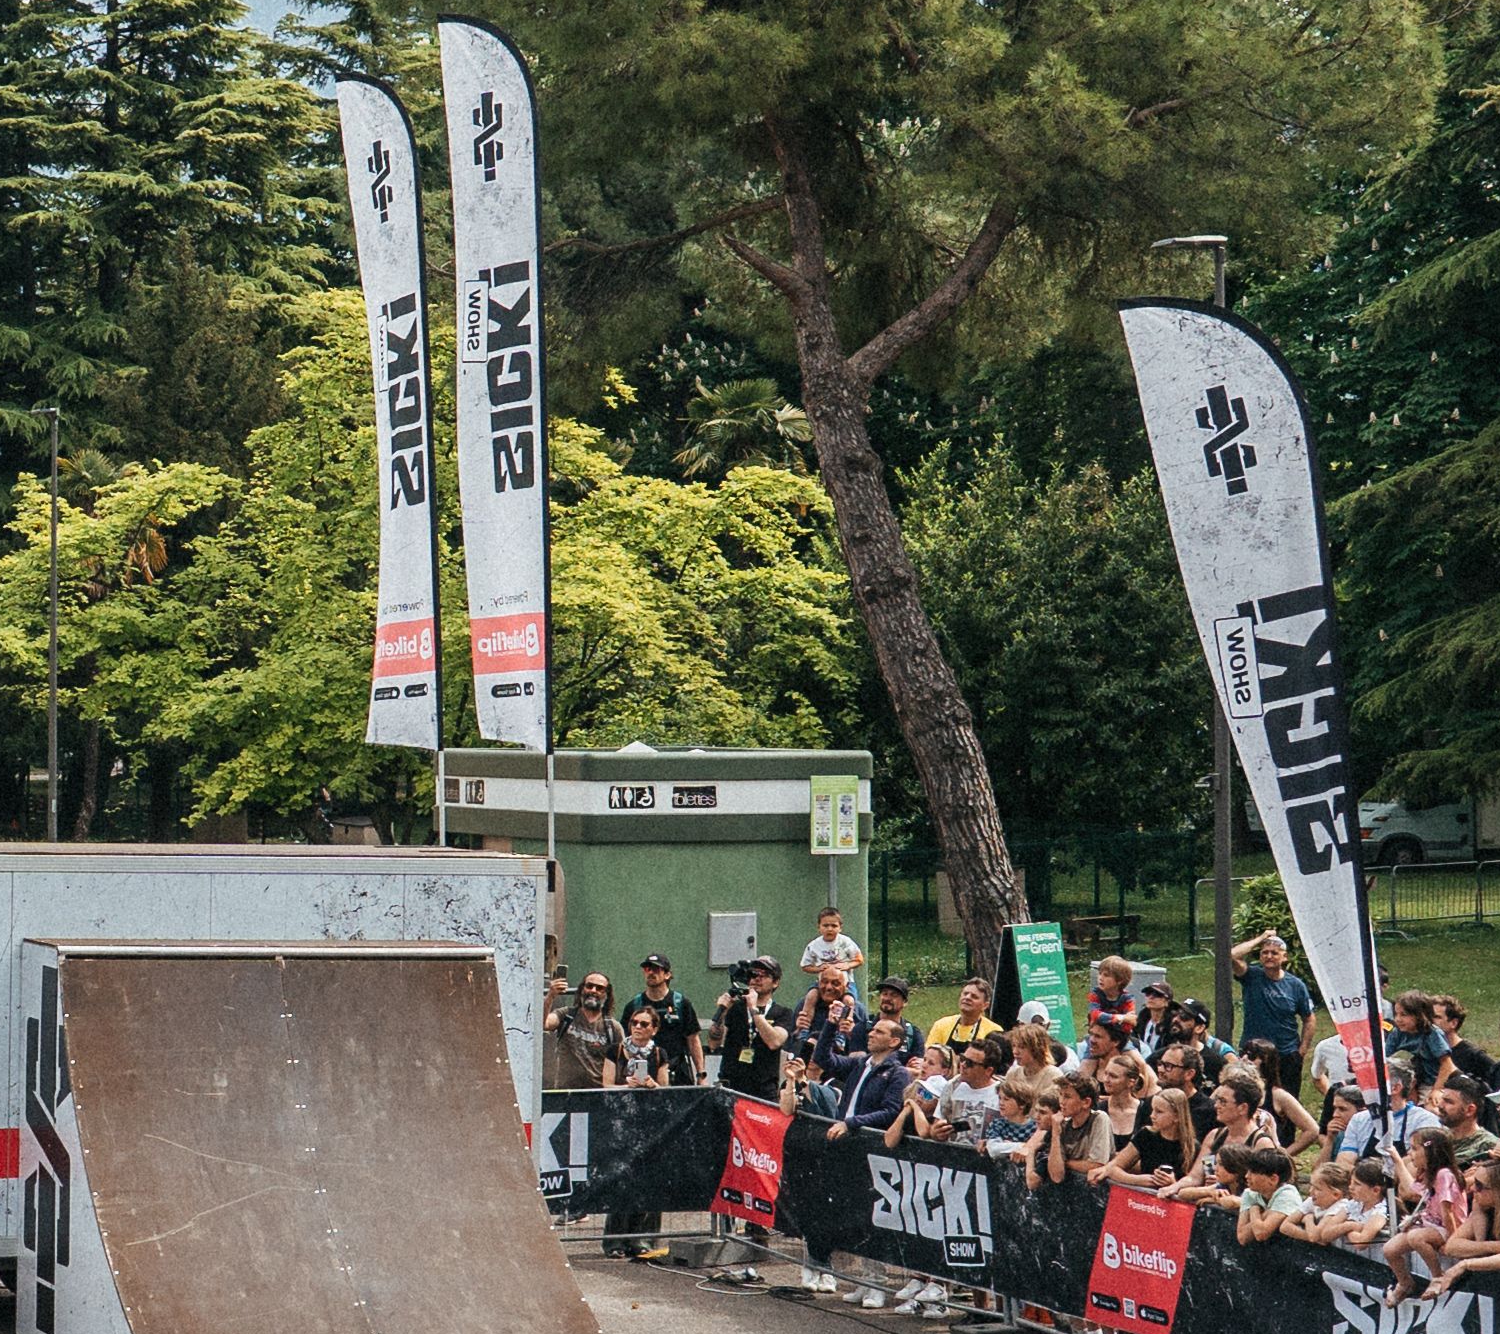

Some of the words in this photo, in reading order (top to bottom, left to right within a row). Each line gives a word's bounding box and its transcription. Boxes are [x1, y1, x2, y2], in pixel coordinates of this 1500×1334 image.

[867, 1153, 993, 1253] SICK!
[949, 1241, 977, 1258] SHOW
[1121, 1241, 1177, 1279] bikeflip
